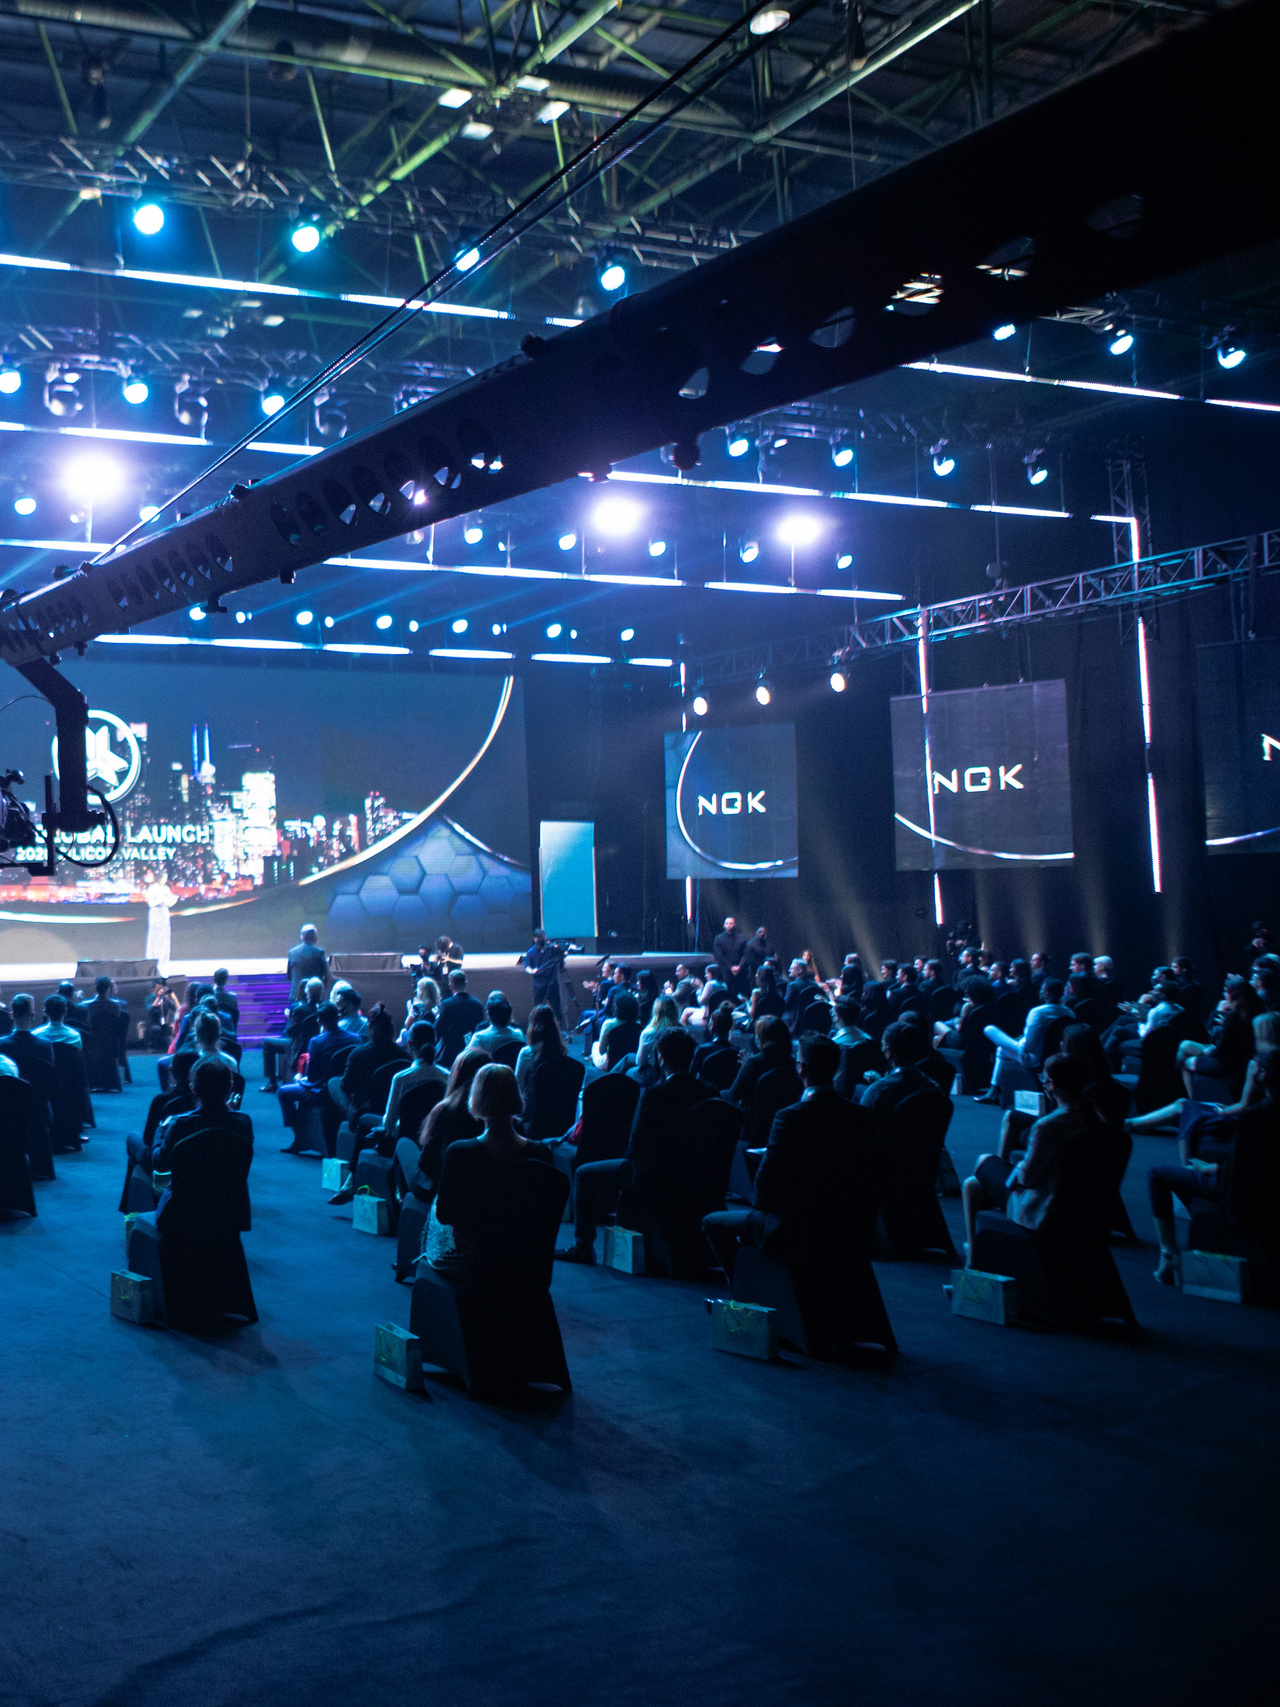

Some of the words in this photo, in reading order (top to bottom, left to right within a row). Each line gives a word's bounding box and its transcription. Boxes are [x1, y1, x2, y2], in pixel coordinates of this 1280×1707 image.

[933, 763, 1025, 795] NGK
[698, 789, 767, 817] NGK
[126, 823, 210, 844] LAUNCH
[121, 845, 177, 861] VALLEY
